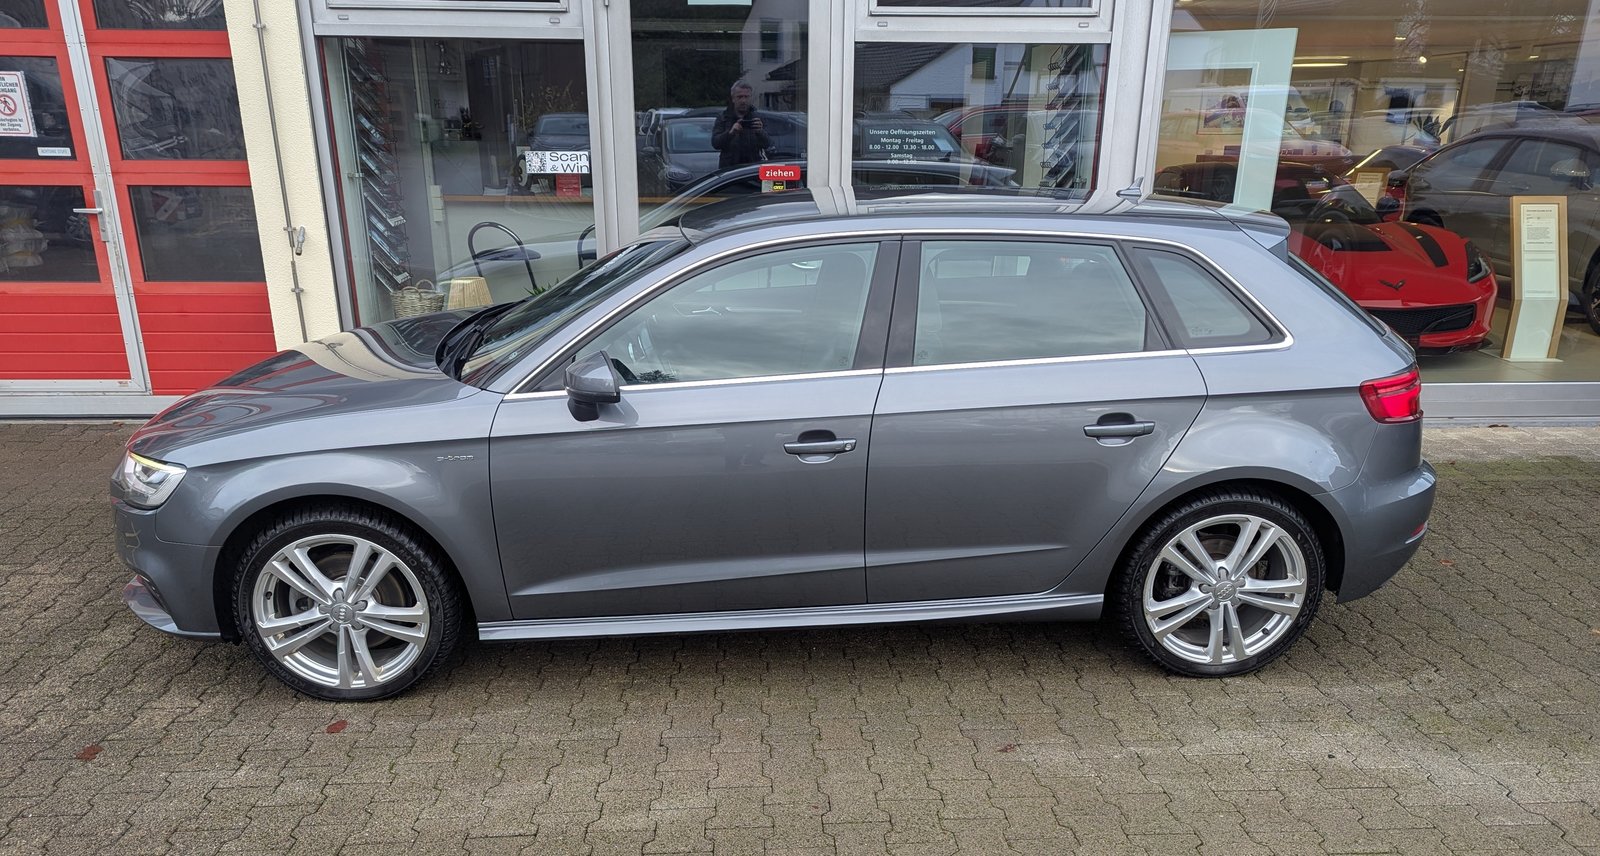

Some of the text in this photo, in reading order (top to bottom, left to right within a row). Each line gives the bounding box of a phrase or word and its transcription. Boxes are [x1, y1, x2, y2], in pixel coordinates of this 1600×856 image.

[549, 152, 589, 162] Scan
[550, 162, 590, 173] & Win
[765, 169, 794, 177] ziehen
